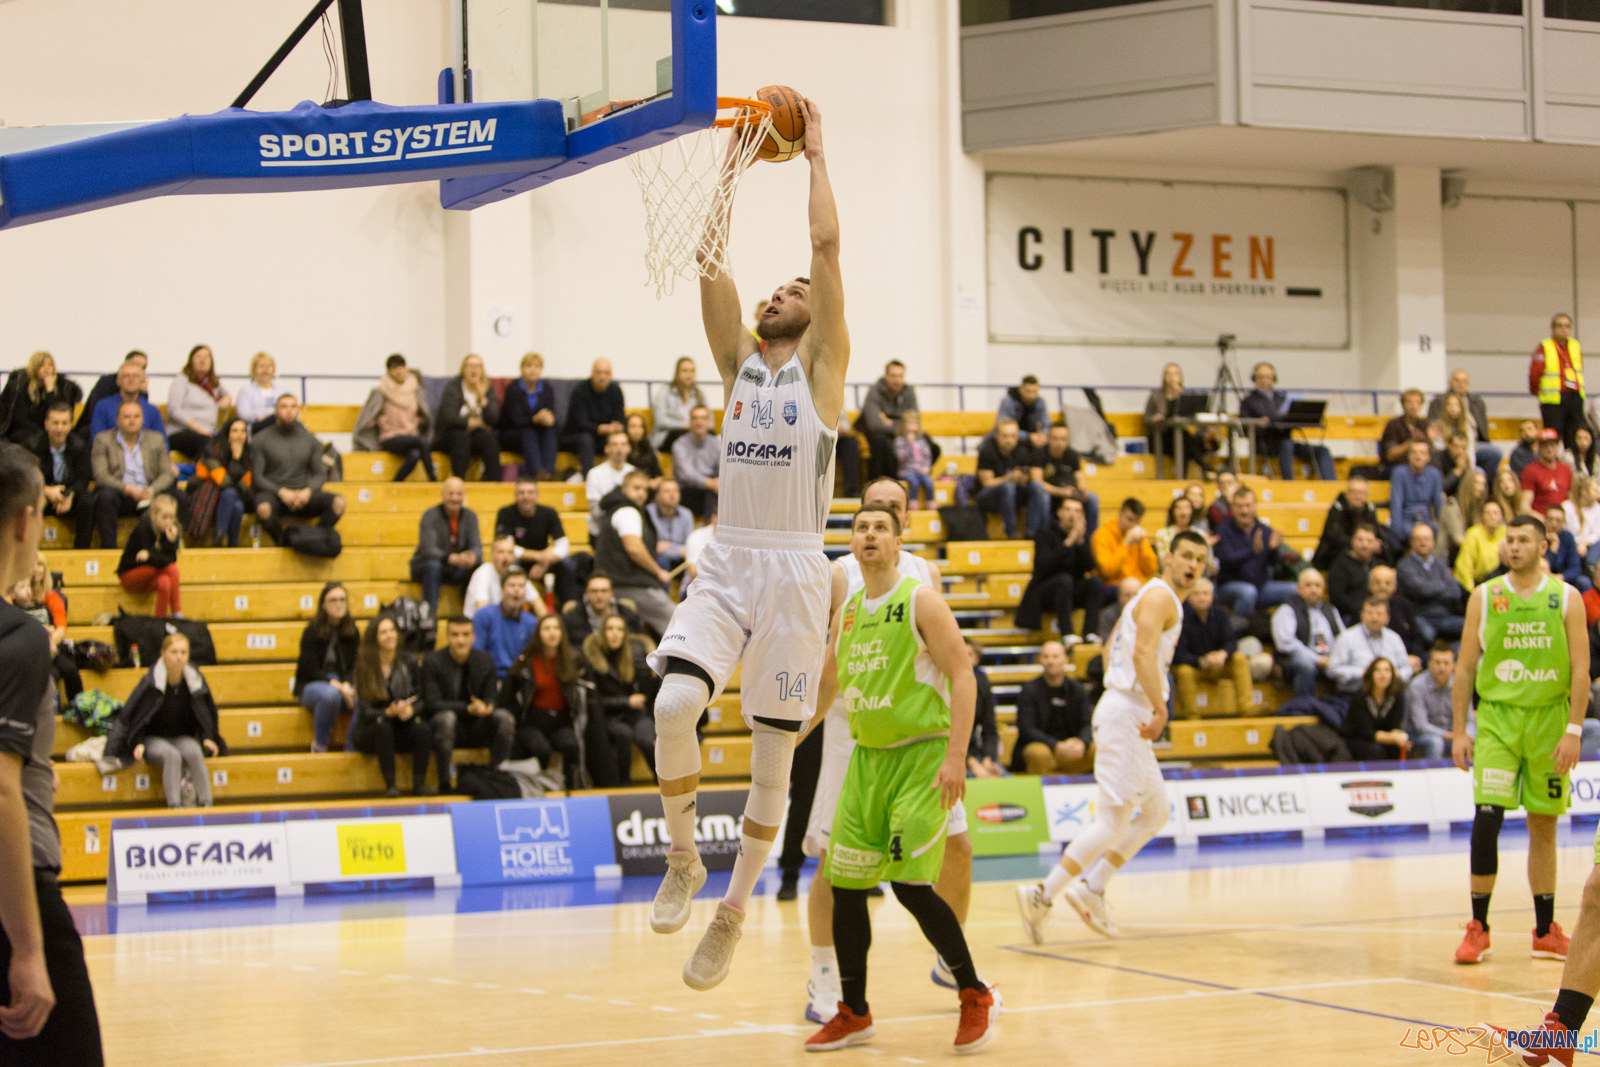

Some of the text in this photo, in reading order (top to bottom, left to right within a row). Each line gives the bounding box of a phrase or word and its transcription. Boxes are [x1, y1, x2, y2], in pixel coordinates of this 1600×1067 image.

[259, 118, 497, 160] SPORT SYSTEM
[1017, 226, 1275, 281] CITYZEN
[751, 400, 774, 429] 14
[885, 603, 905, 623] 14
[1548, 594, 1560, 609] 5
[1507, 622, 1547, 635] ZNICZ
[1503, 636, 1554, 650] BASKET
[776, 672, 807, 702] 14
[1548, 778, 1562, 799] 5
[1218, 792, 1306, 817] NICKEL
[126, 839, 273, 868] BIOFARM
[501, 846, 572, 866] HOTEL
